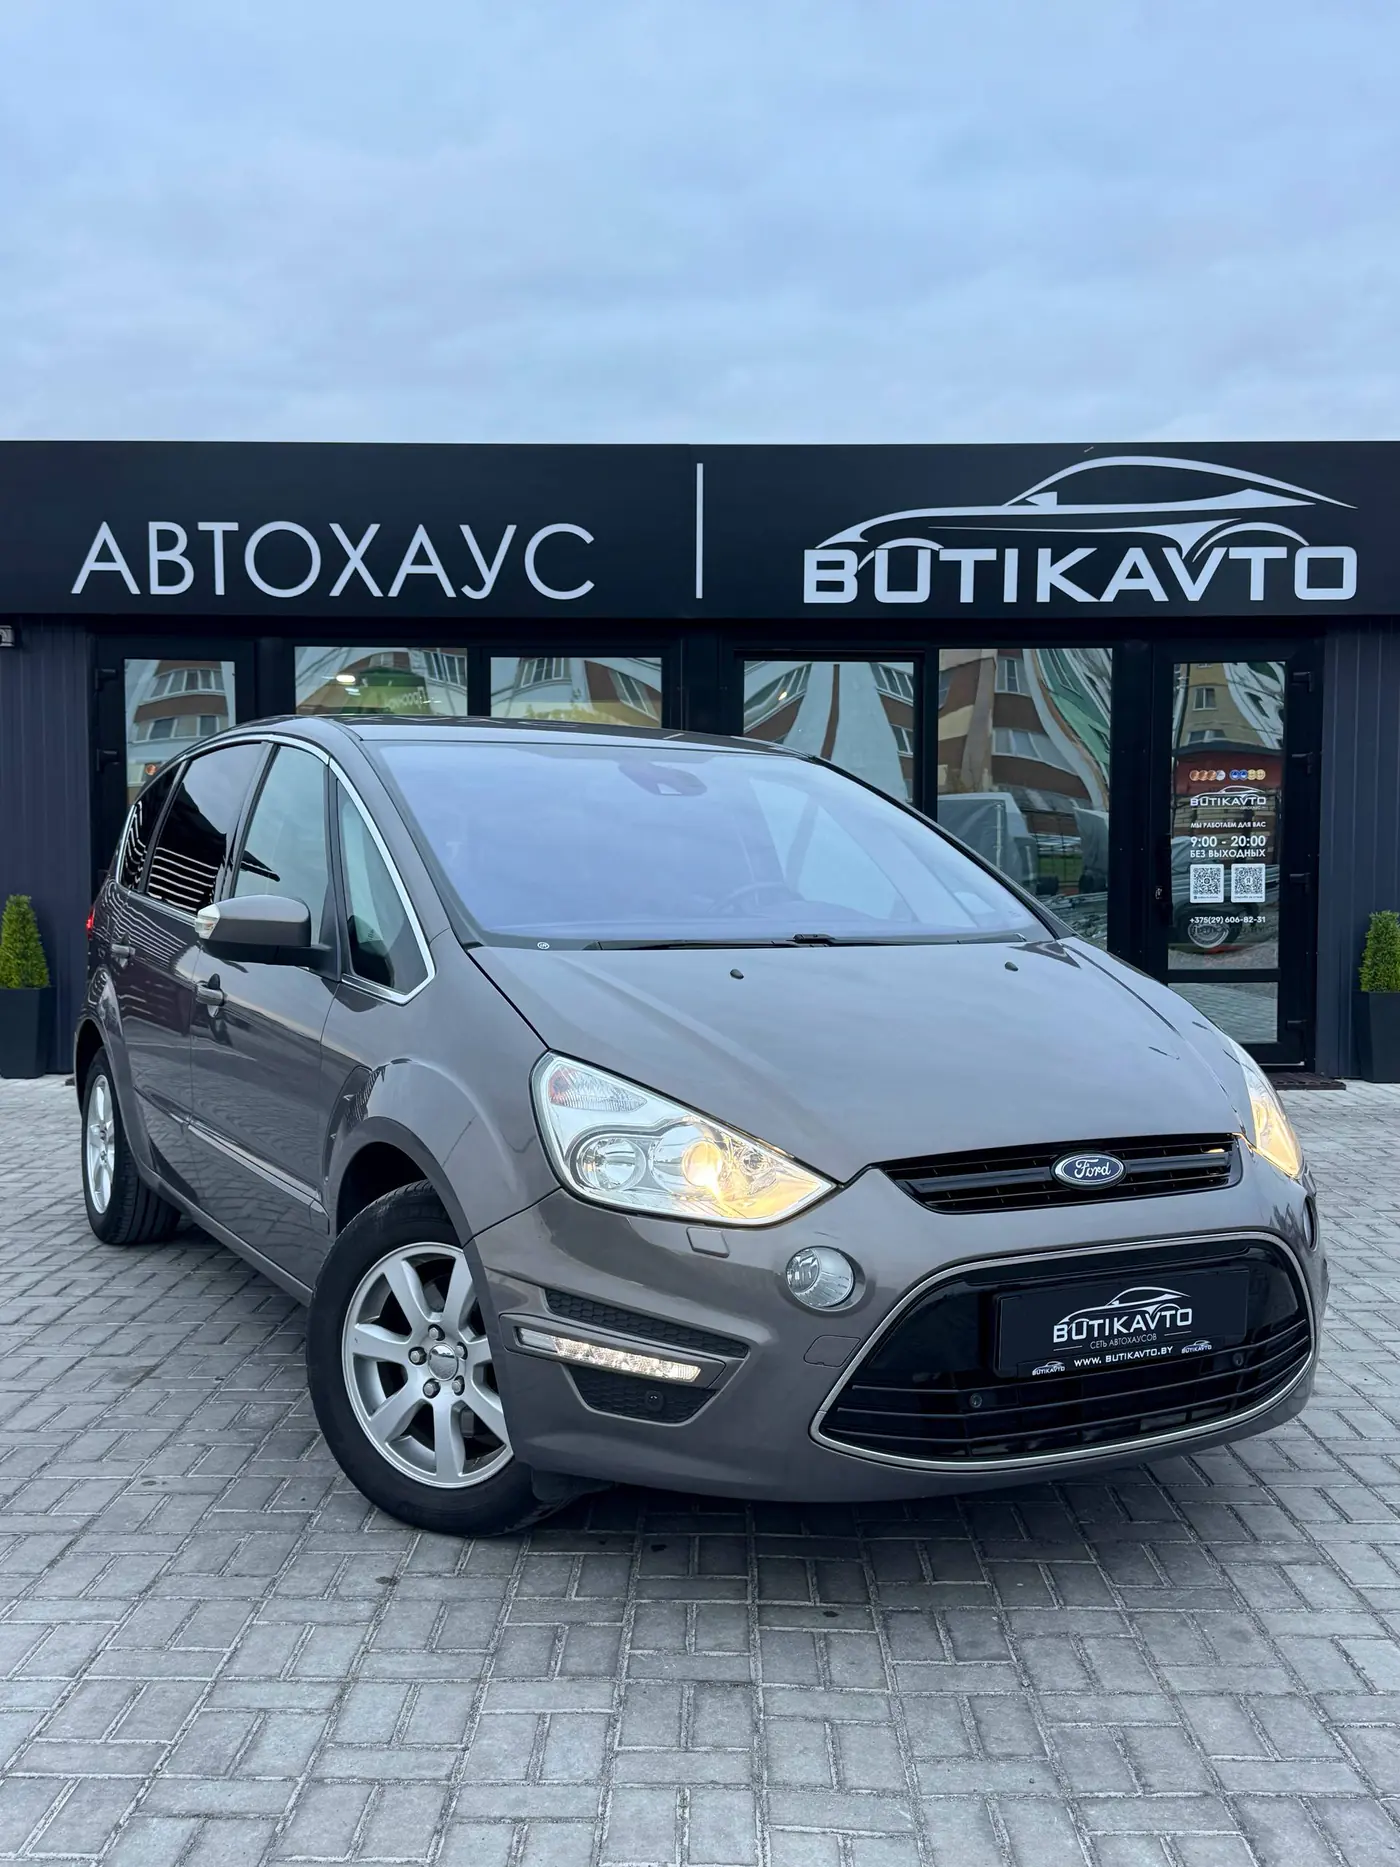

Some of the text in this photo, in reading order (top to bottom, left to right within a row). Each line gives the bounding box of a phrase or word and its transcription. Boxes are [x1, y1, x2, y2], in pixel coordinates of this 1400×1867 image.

[72, 521, 595, 600] АВТОХАУС
[804, 546, 1357, 604] BUTIKAVTO
[1190, 797, 1266, 806] BUTIKAVTO
[1191, 836, 1217, 847] 9:00
[1231, 836, 1266, 847] 20:00
[1190, 849, 1266, 858] БЕЗ ВЫХОДНЫХ
[1190, 916, 1224, 924] +375(29)
[1074, 1158, 1112, 1178] Ford
[1053, 1308, 1193, 1343] BUTIKAVTO
[1090, 1333, 1157, 1350] СЕТЬ АВТОХАУСОВ
[1181, 1345, 1212, 1353] BUTIKAVTO
[1074, 1346, 1174, 1367] WWW. BUTIKAVTO.BY
[1032, 1366, 1065, 1376] BUTIKAVTO
